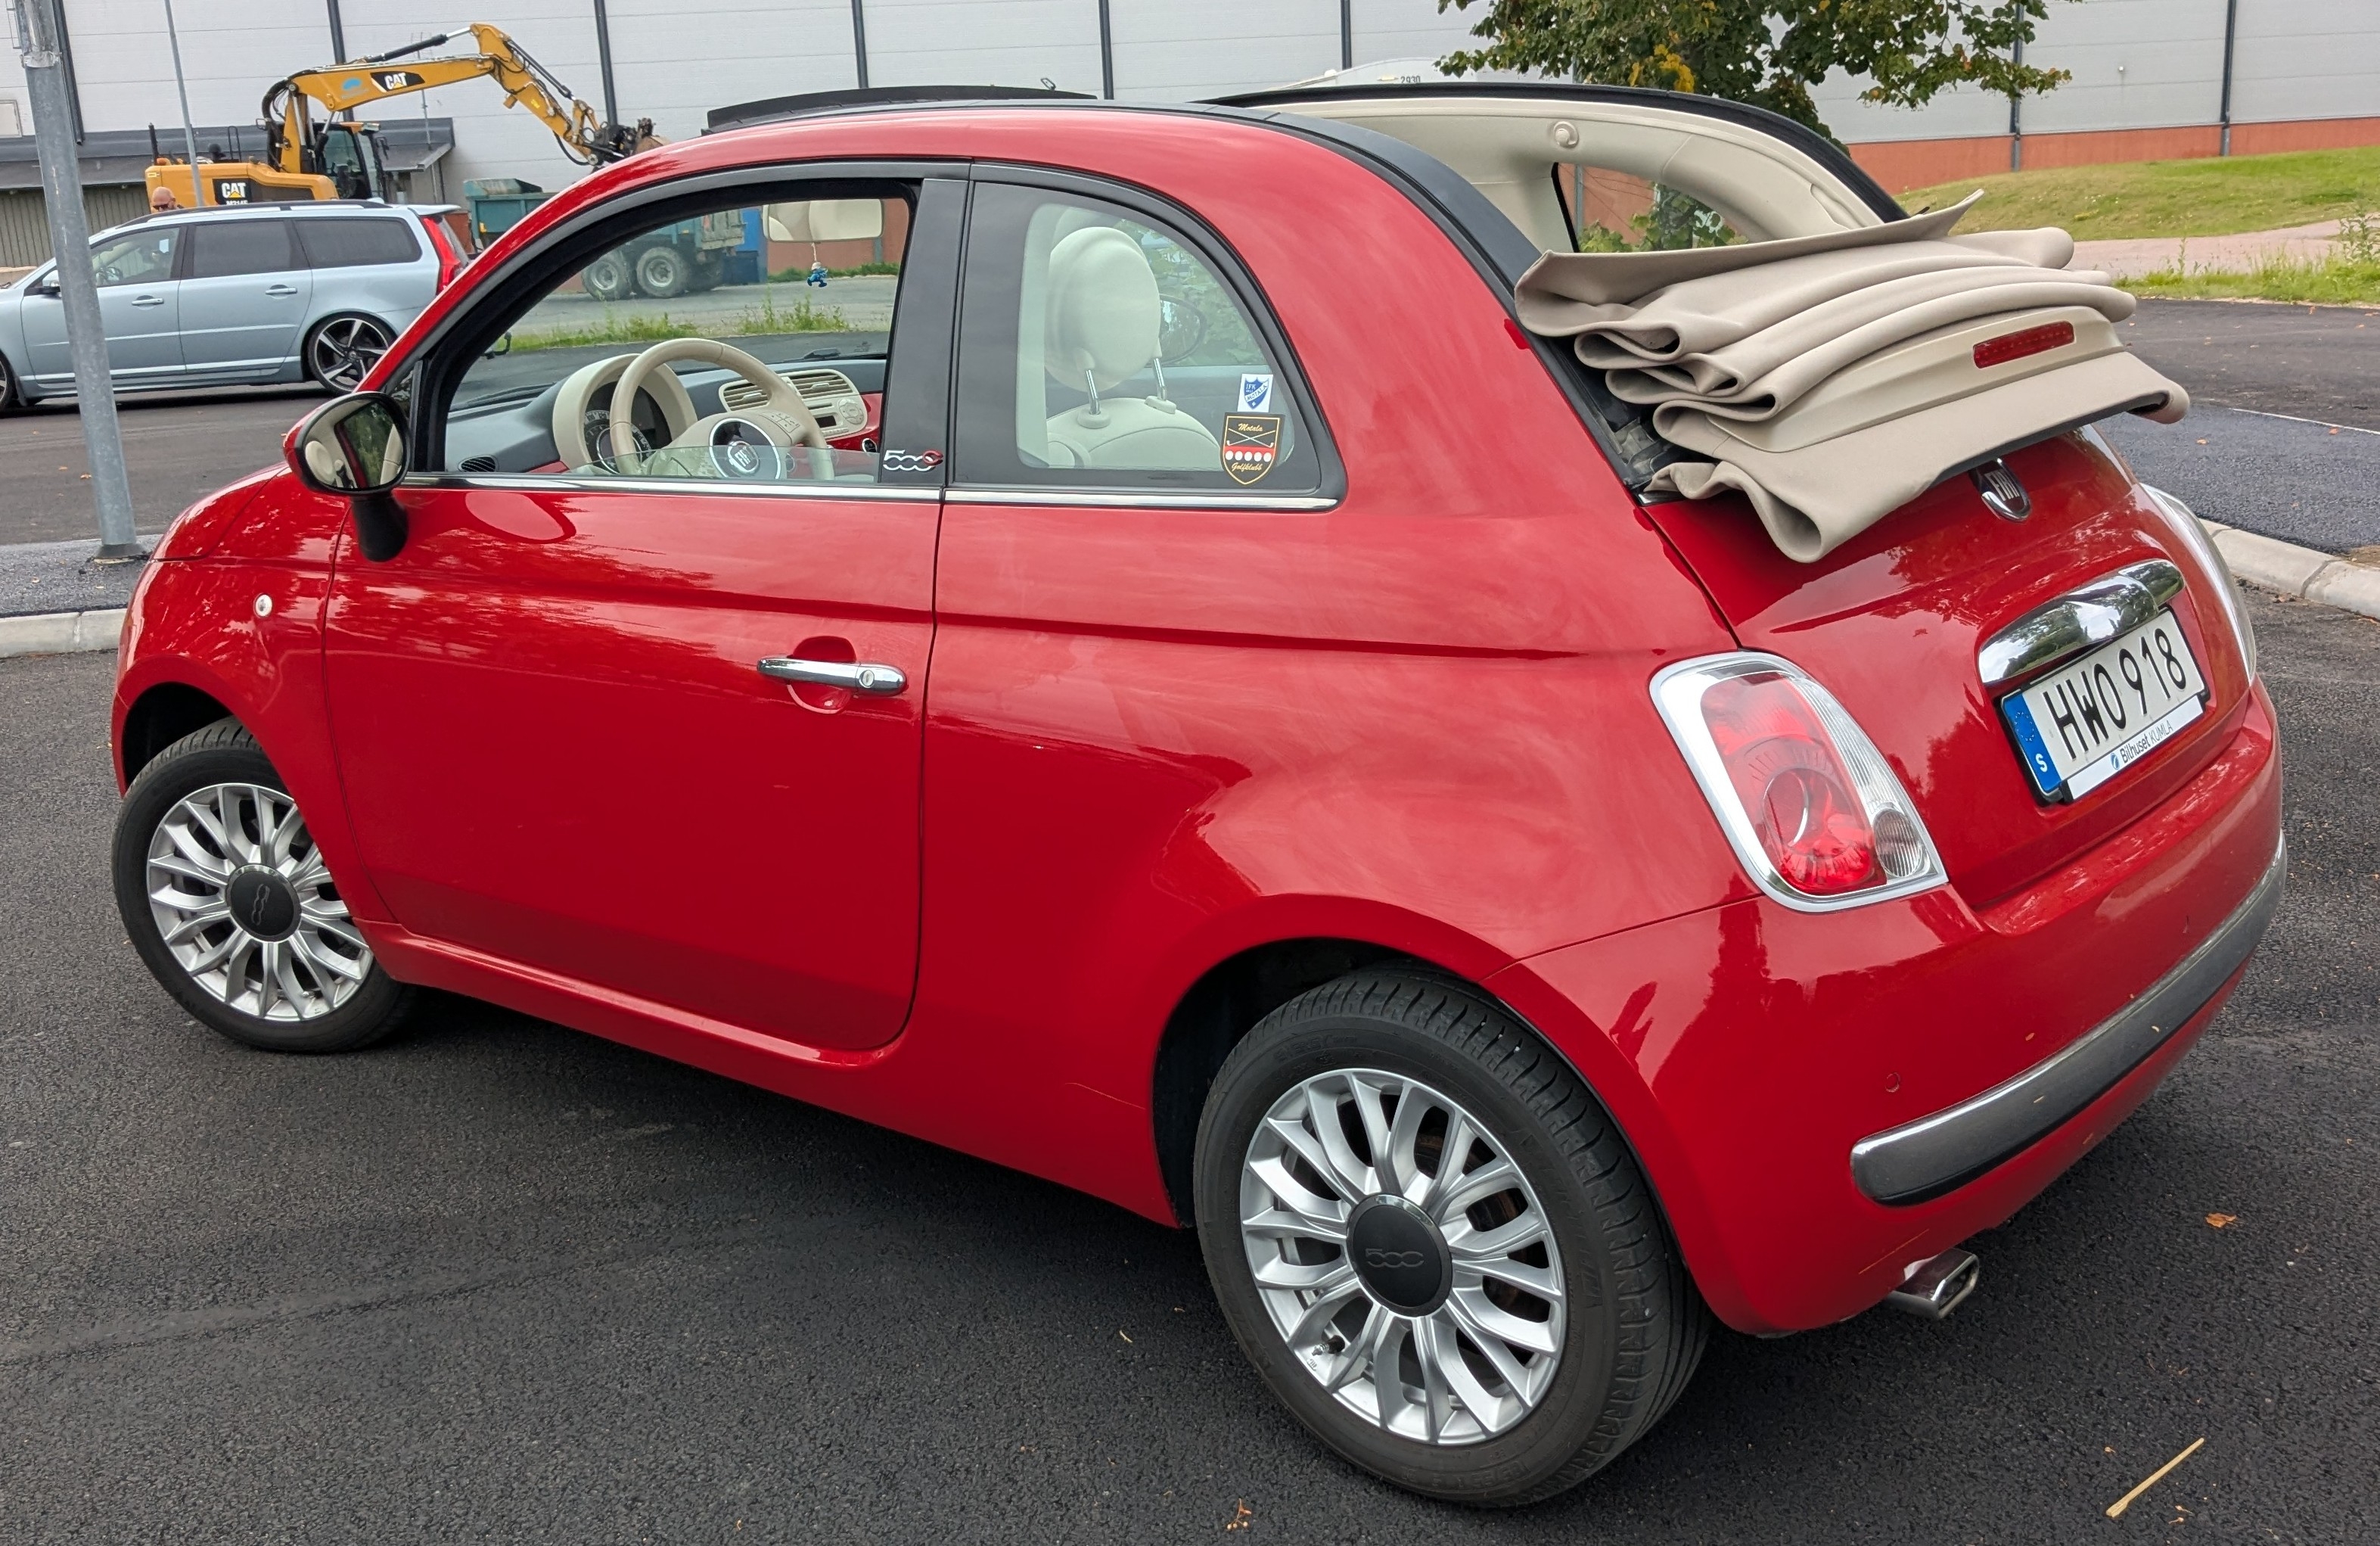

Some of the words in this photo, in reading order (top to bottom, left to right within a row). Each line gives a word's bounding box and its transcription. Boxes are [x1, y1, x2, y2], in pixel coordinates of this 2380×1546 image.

[384, 73, 407, 89] CAT
[221, 182, 247, 198] CAT
[1247, 384, 1267, 400] MOTALA
[1238, 423, 1263, 431] Motala
[1231, 462, 1263, 472] Golfklubb
[2043, 663, 2127, 761] HWO
[2119, 628, 2186, 716] 918
[2120, 733, 2150, 764] Bilhuset
[2149, 720, 2173, 745] KUMLA
[2035, 754, 2048, 773] S
[1365, 1248, 1424, 1268] 500
